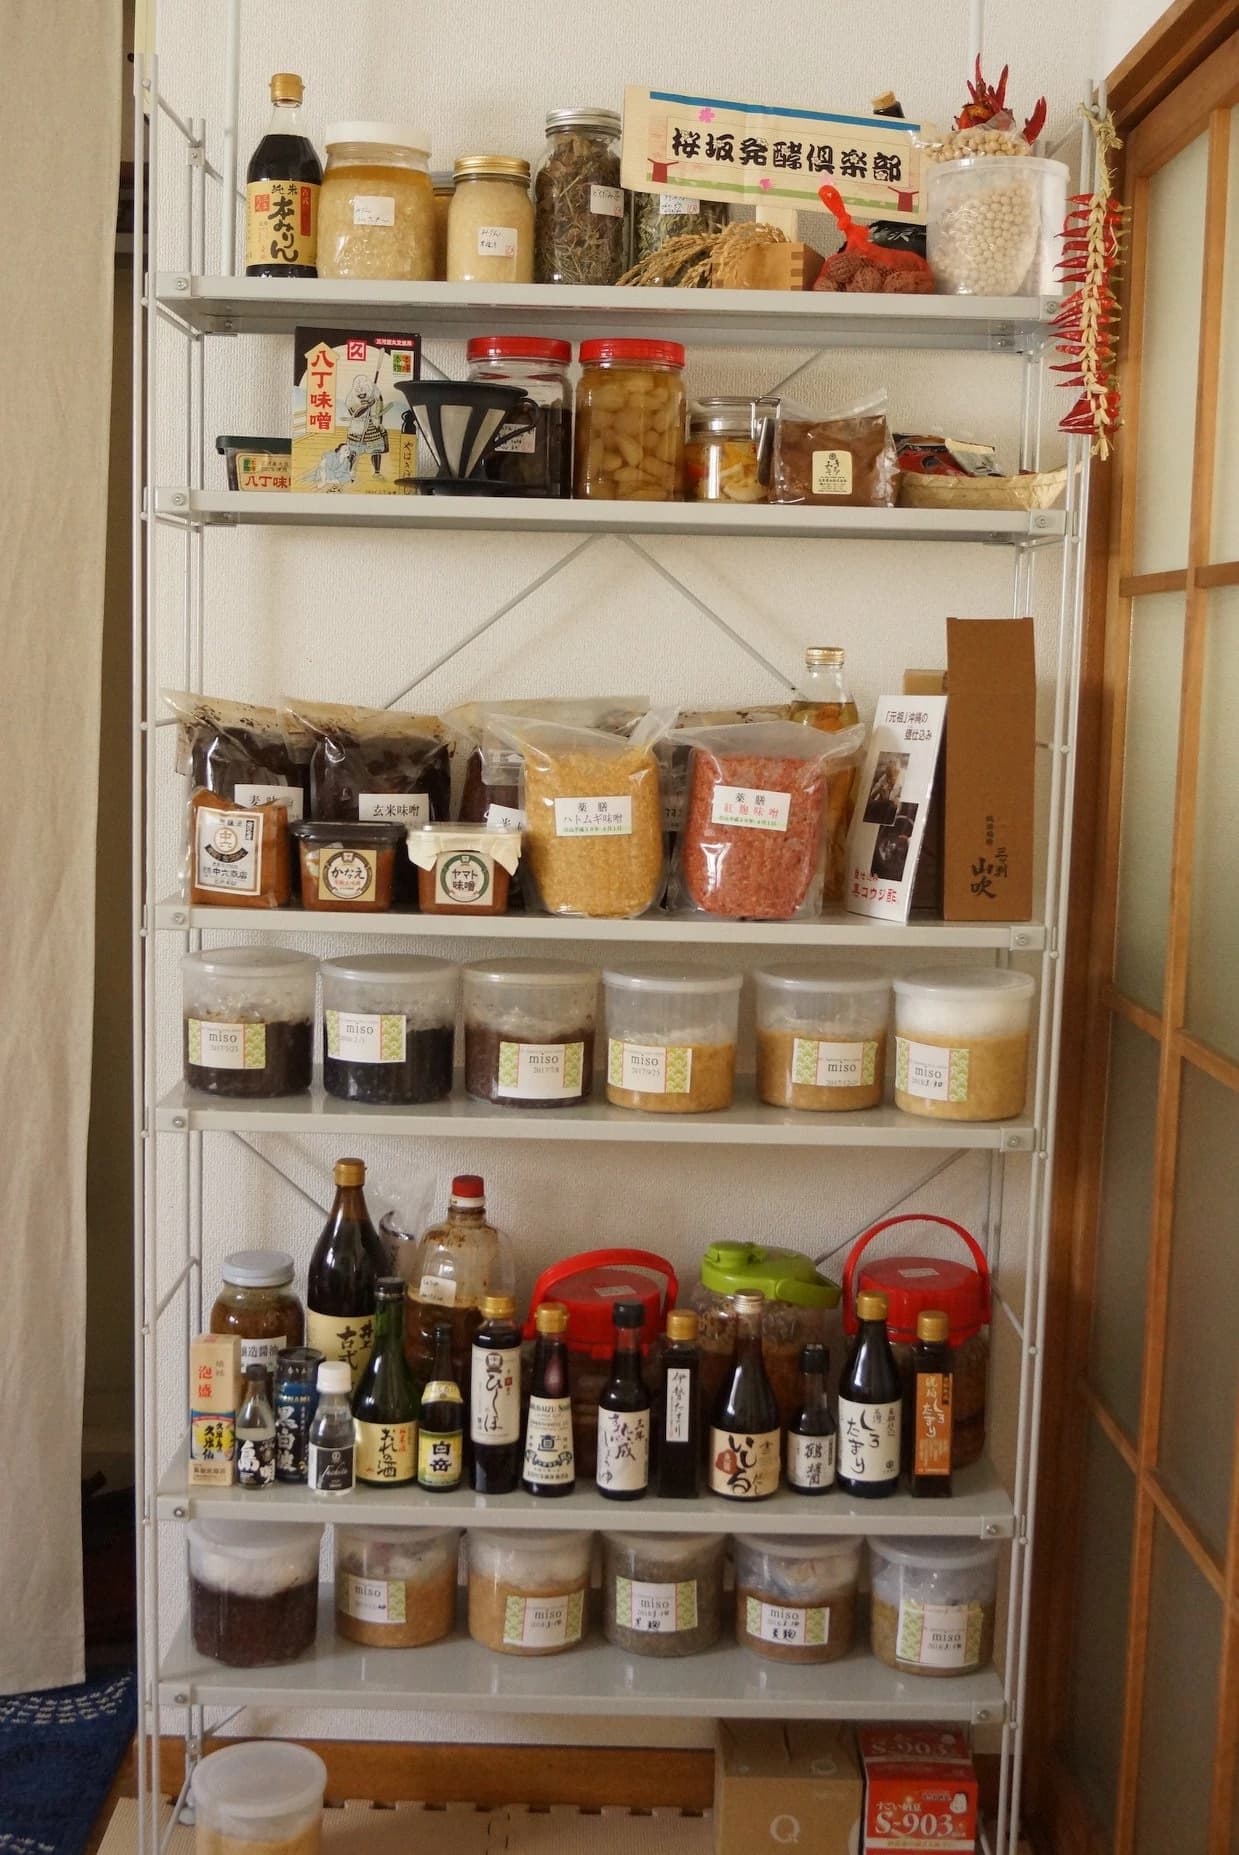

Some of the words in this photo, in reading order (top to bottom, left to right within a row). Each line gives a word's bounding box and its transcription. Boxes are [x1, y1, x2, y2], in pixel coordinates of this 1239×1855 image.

[671, 127, 902, 183] 桜坂発酵倶楽部
[268, 196, 299, 262] 本みりん
[310, 351, 335, 430] 八丁味噌
[246, 476, 291, 488] 八丁味
[373, 804, 420, 816] 玄米味噌
[564, 813, 623, 824] ハトムギ味噌
[331, 867, 365, 879] かなえ
[451, 868, 478, 880] ヤマト
[452, 880, 476, 892] 味噌
[346, 1022, 374, 1035] miso
[208, 1030, 238, 1043] miso
[528, 1052, 560, 1064] miso
[631, 1054, 659, 1066] miso
[827, 1060, 857, 1072] miso
[914, 1066, 942, 1079] miso
[354, 1585, 381, 1597] miso
[640, 1597, 670, 1609] miso
[534, 1608, 562, 1620] miso
[769, 1607, 800, 1620] miso
[931, 1631, 961, 1642] miso
[875, 1811, 954, 1837] S-903
